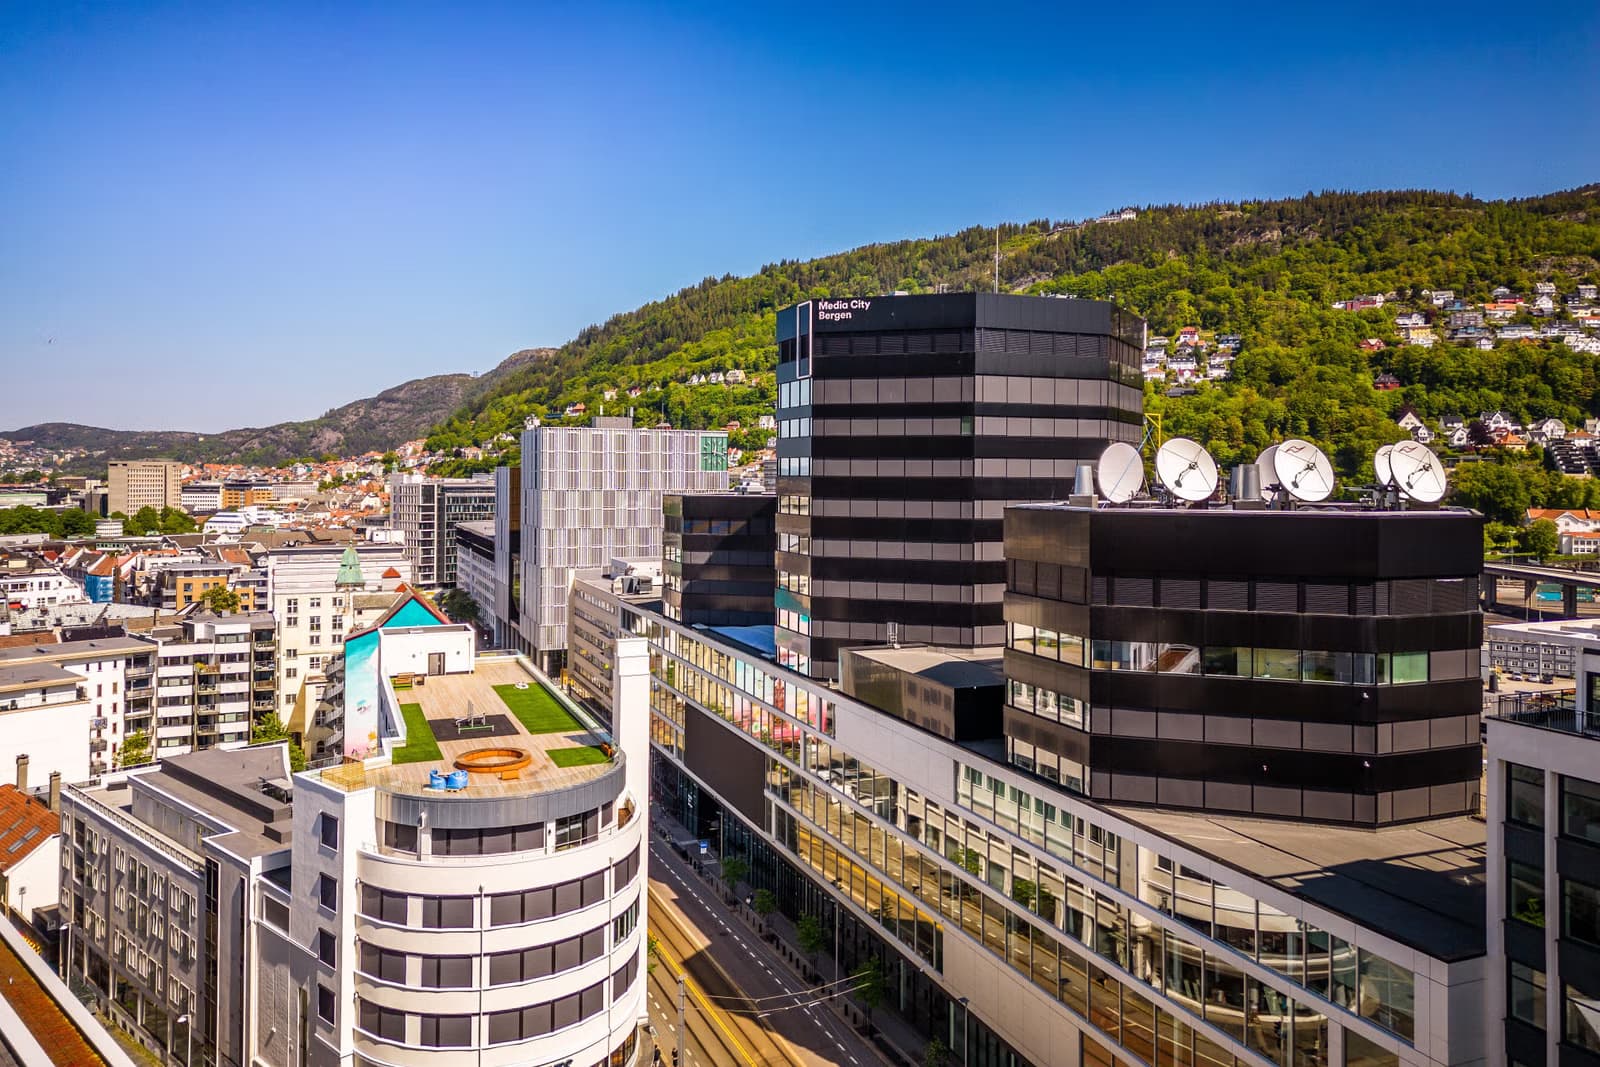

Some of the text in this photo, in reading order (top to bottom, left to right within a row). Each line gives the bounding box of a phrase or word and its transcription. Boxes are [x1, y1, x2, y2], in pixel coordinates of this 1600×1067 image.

[818, 299, 871, 311] Media City
[818, 311, 852, 321] Bergen
